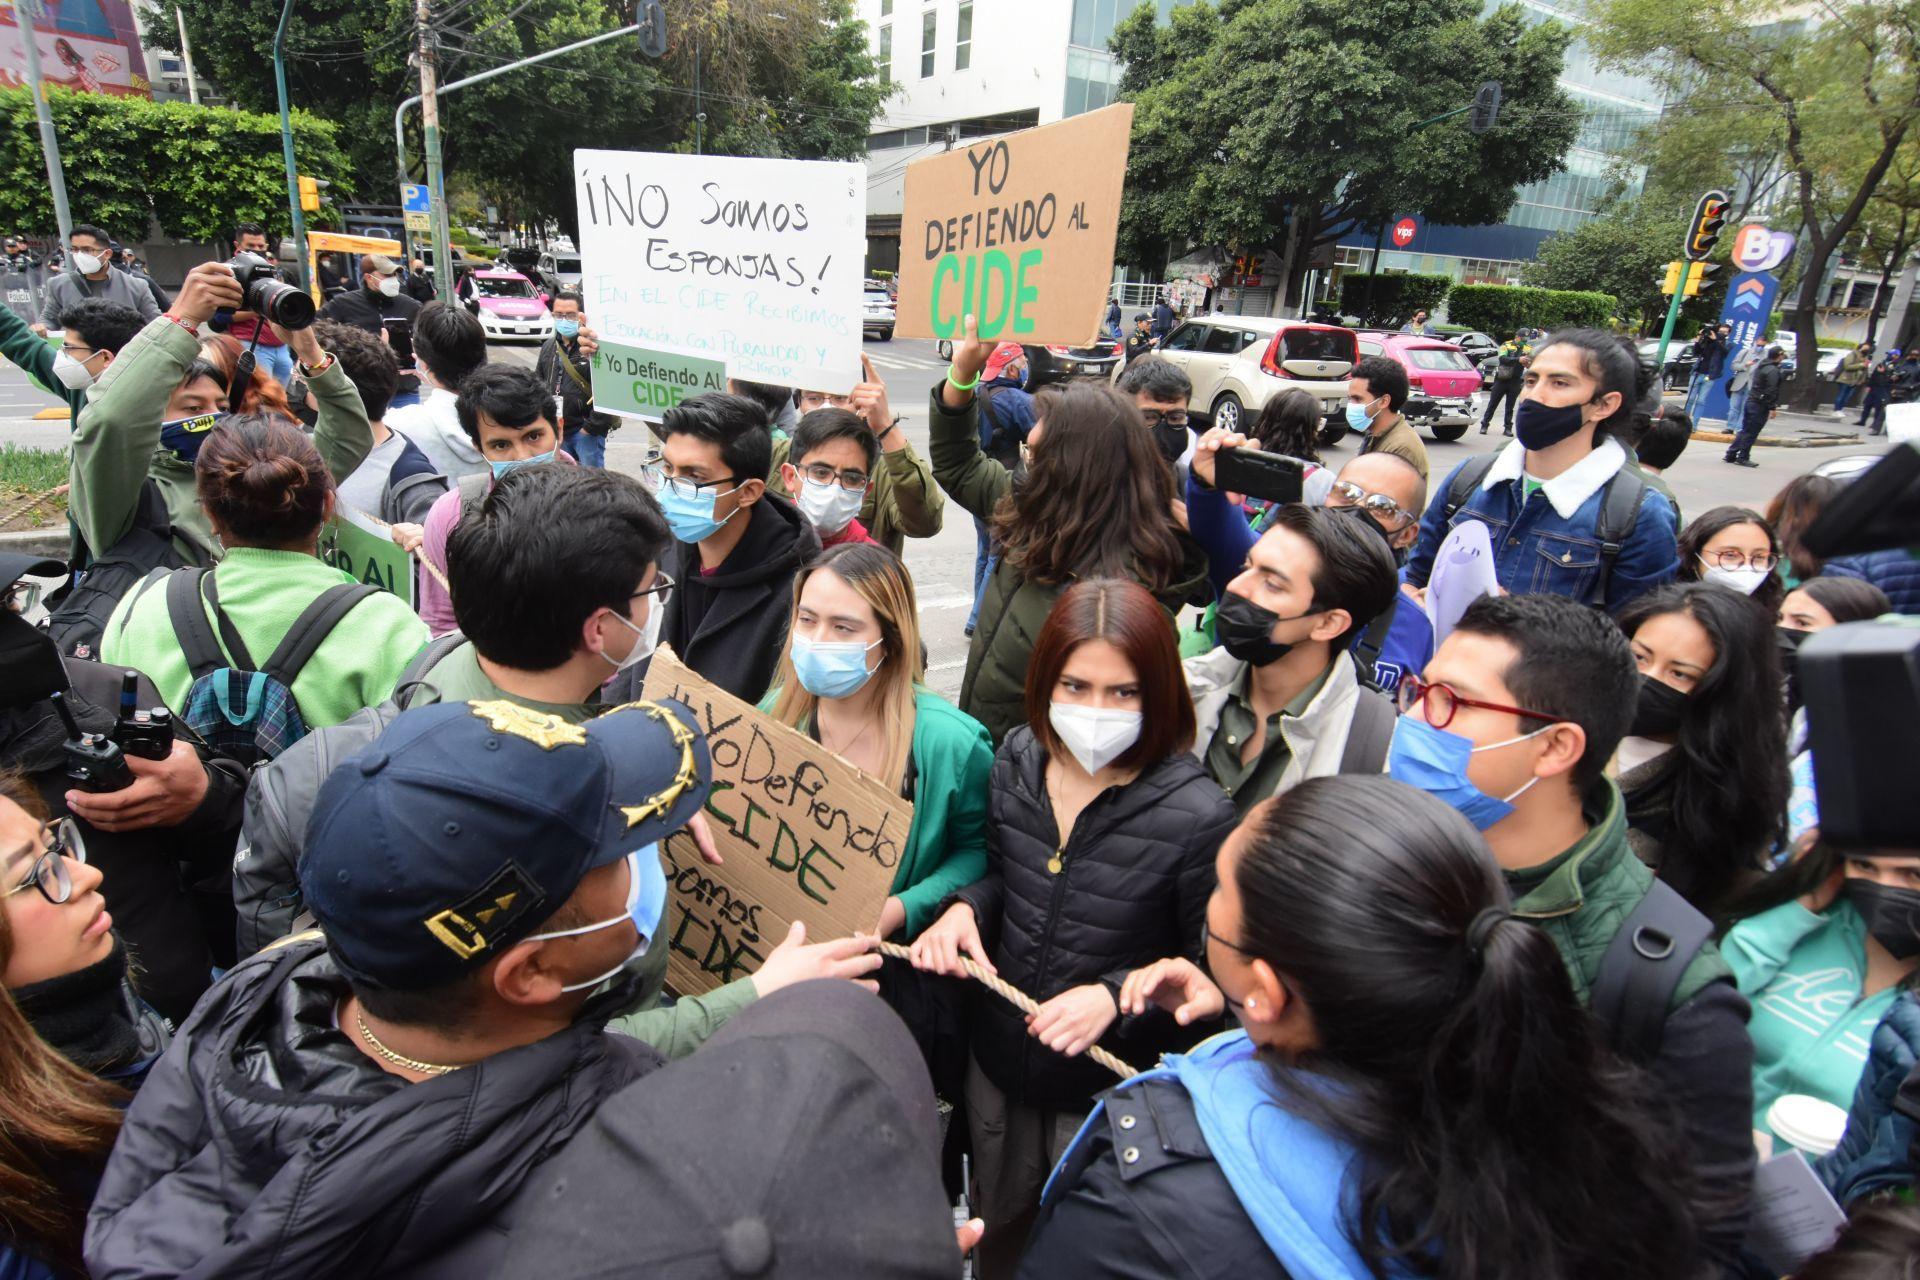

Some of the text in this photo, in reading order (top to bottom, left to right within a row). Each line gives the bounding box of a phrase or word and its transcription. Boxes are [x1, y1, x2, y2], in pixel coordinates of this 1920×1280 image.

[968, 140, 1010, 196] YO
[925, 193, 1090, 260] DEFIENDO AL
[1397, 226, 1414, 240] vips
[931, 248, 1043, 339] CIDE
[605, 353, 622, 373] Yo
[627, 358, 699, 387] Defiendo
[704, 372, 722, 391] Al
[704, 779, 846, 906] CIDE
